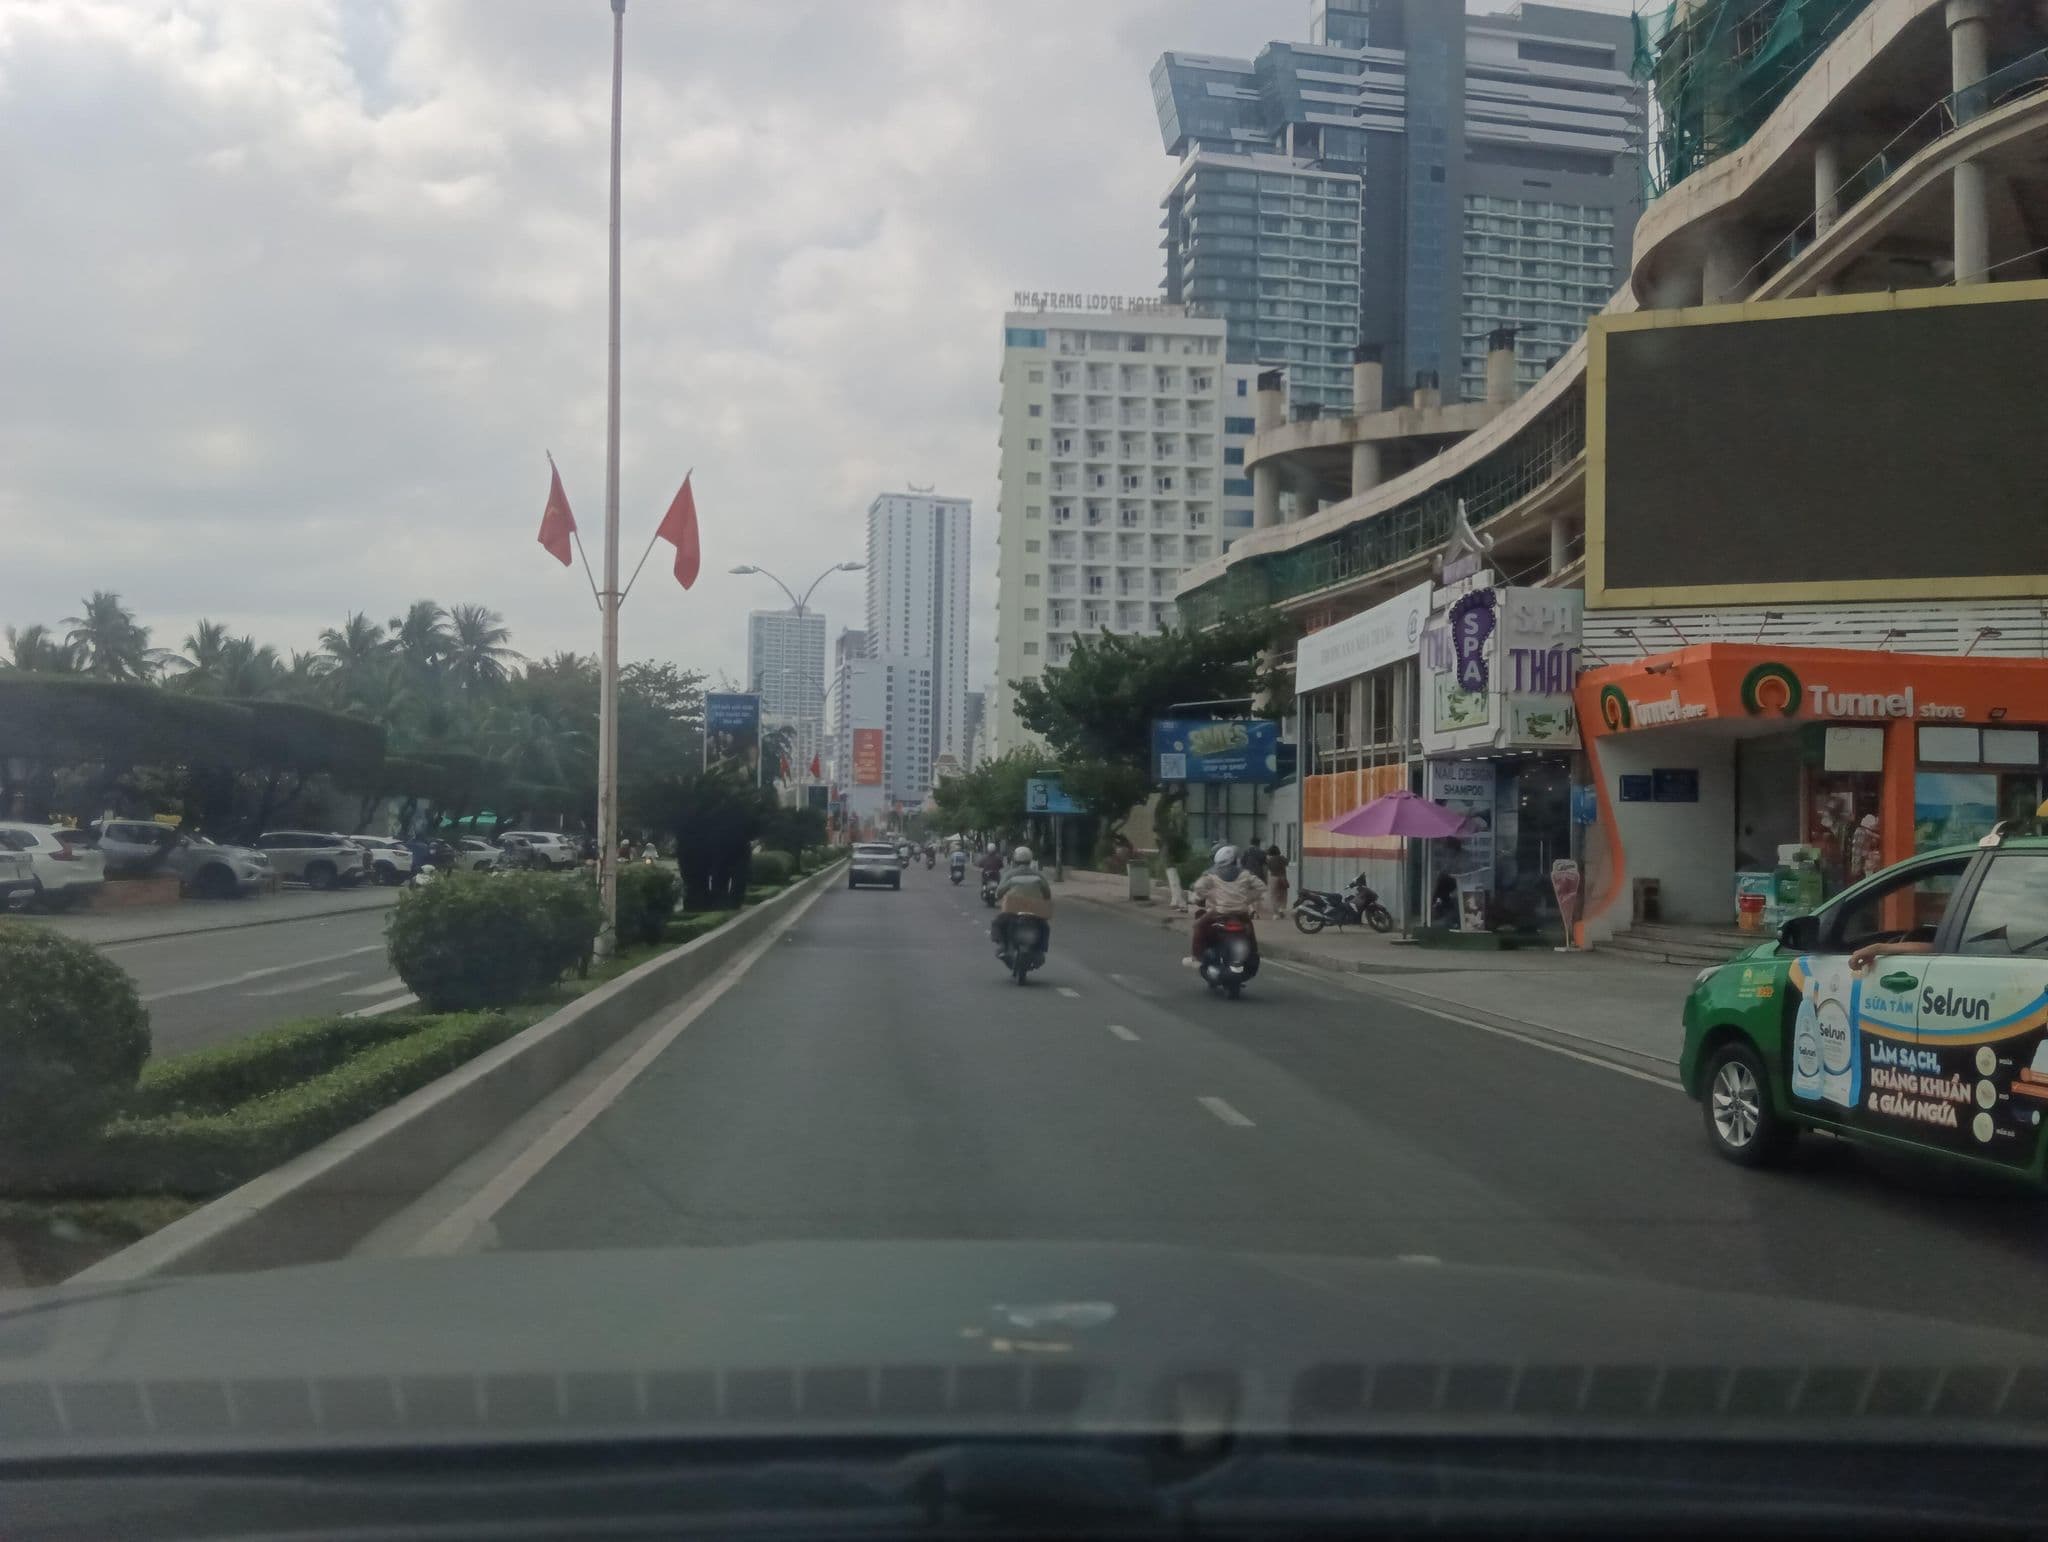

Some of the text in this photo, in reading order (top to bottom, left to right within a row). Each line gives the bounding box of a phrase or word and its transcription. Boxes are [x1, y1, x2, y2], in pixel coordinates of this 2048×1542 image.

[1014, 290, 1039, 308] NHA
[1043, 291, 1082, 310] TRANG
[1087, 293, 1124, 312] LODGE
[1463, 612, 1482, 682] SPA
[1629, 689, 1682, 727] Tunnel
[1807, 685, 1966, 719] Tunnel store
[1443, 784, 1485, 796] SHAMPOO
[1922, 986, 1990, 1021] Selsun
[1819, 1022, 1846, 1041] Selsun
[1871, 1066, 1972, 1104] KHÁNG KHUẨN
[1867, 1091, 1879, 1112] &
[1880, 1092, 1916, 1118] GIẢM
